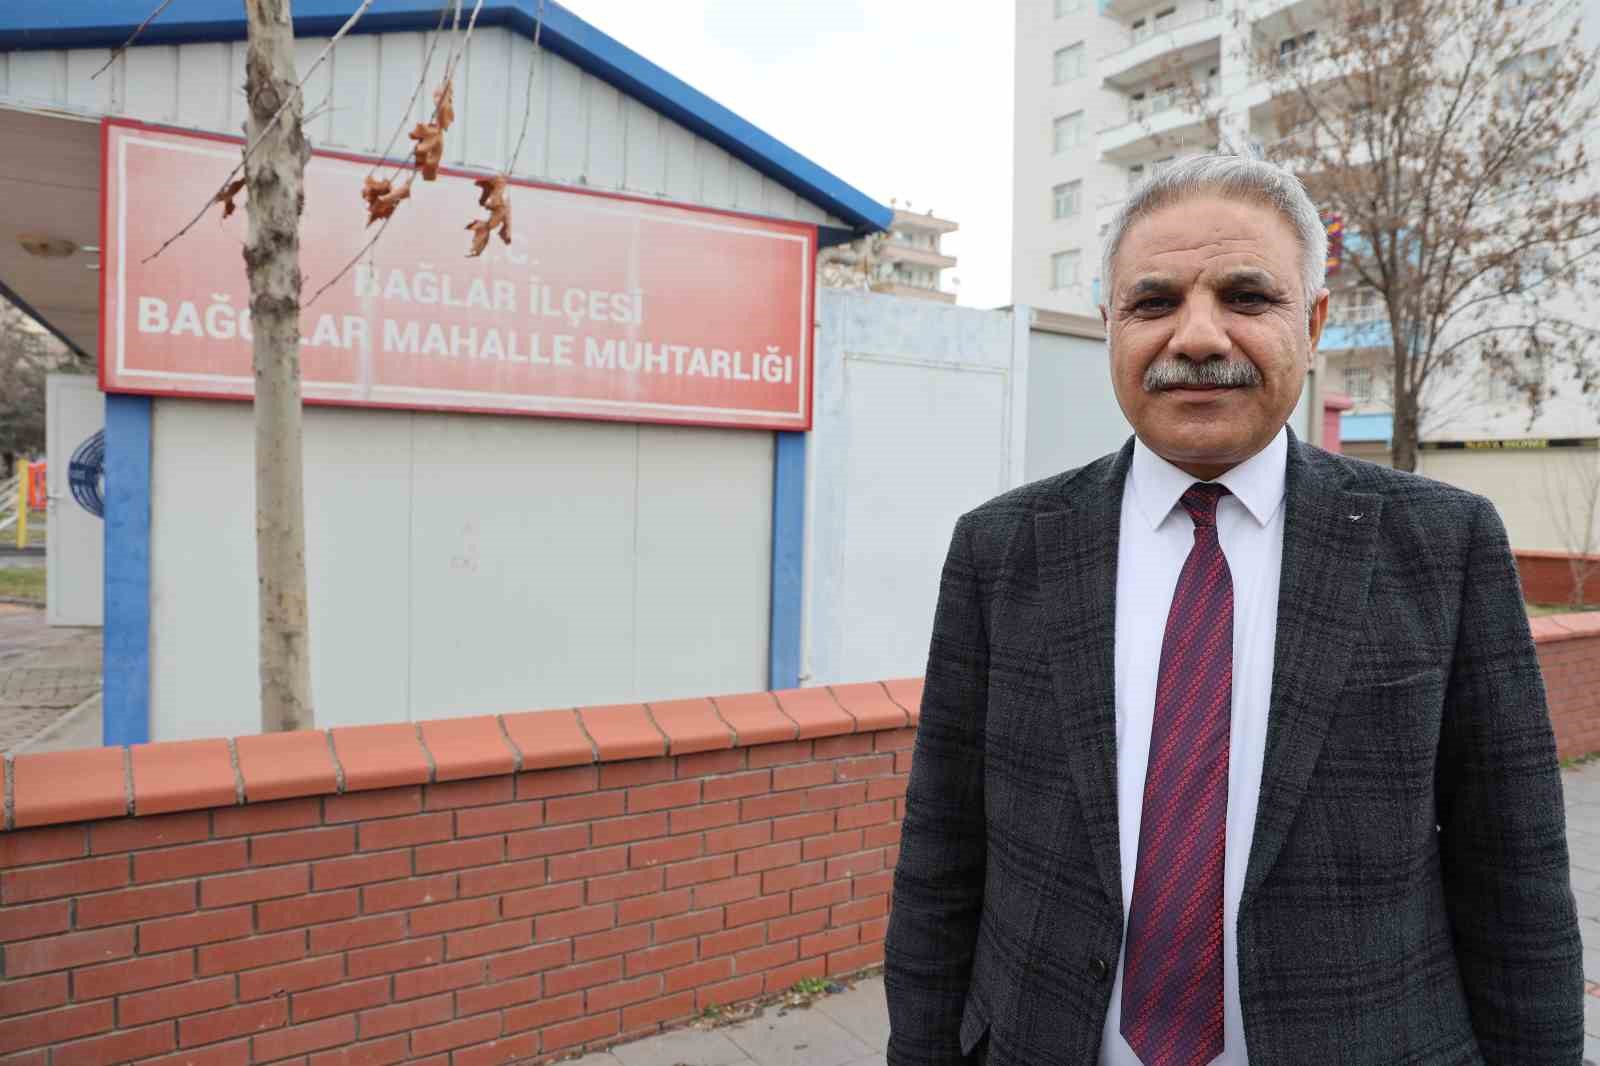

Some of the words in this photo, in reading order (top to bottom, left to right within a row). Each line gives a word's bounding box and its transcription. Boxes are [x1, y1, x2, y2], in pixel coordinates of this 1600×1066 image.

[353, 261, 516, 312] BAĞLAR
[529, 276, 643, 326] İLÇESİ
[383, 318, 575, 367] MAHALLE
[584, 336, 793, 384] MUHTARLIĞI
